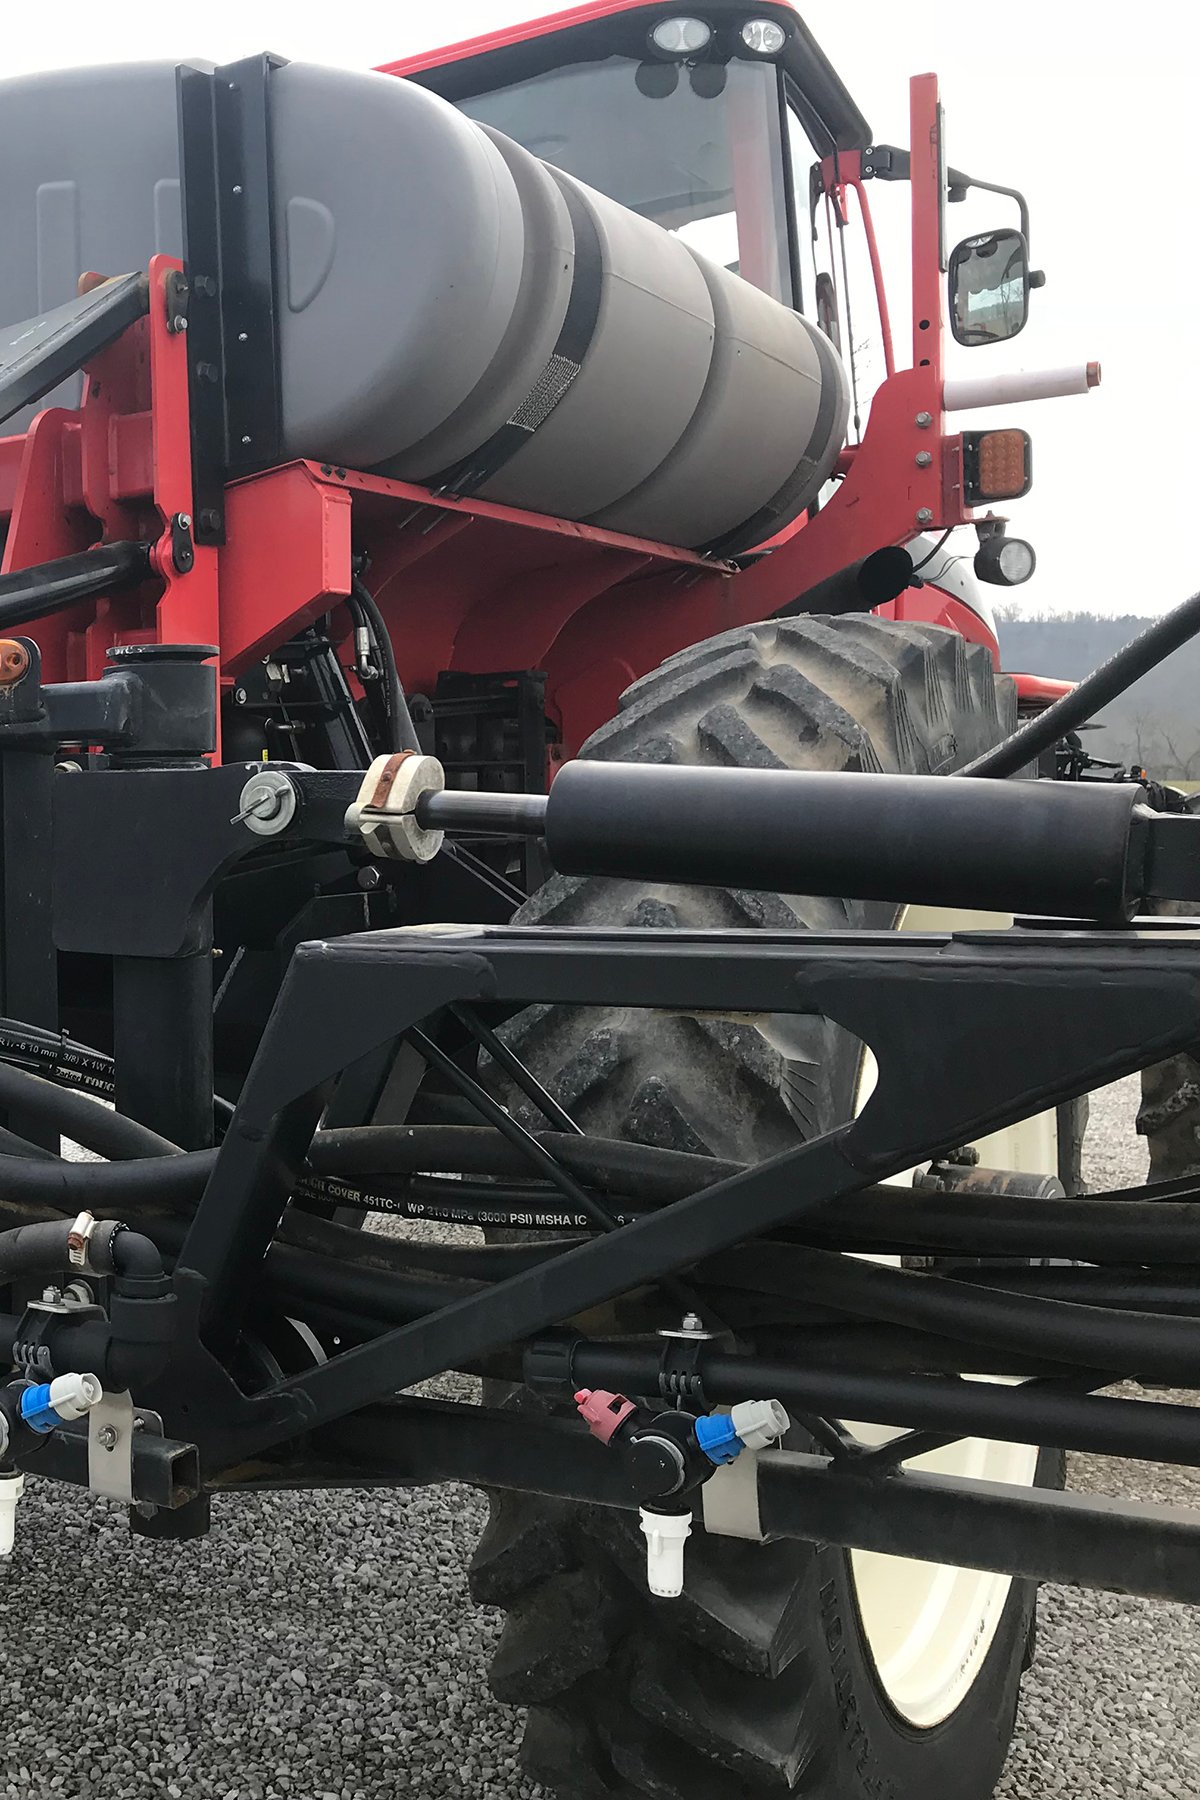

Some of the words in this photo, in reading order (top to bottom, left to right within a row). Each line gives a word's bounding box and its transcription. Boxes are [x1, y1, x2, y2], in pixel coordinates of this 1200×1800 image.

[62, 1051, 80, 1065] 3/8)
[327, 1183, 361, 1203] COVER
[363, 1195, 401, 1210] 451TC-
[406, 1202, 425, 1215] WP
[477, 1210, 507, 1224] (3000
[509, 1213, 533, 1226] PSI)
[535, 1214, 572, 1227] MSHA
